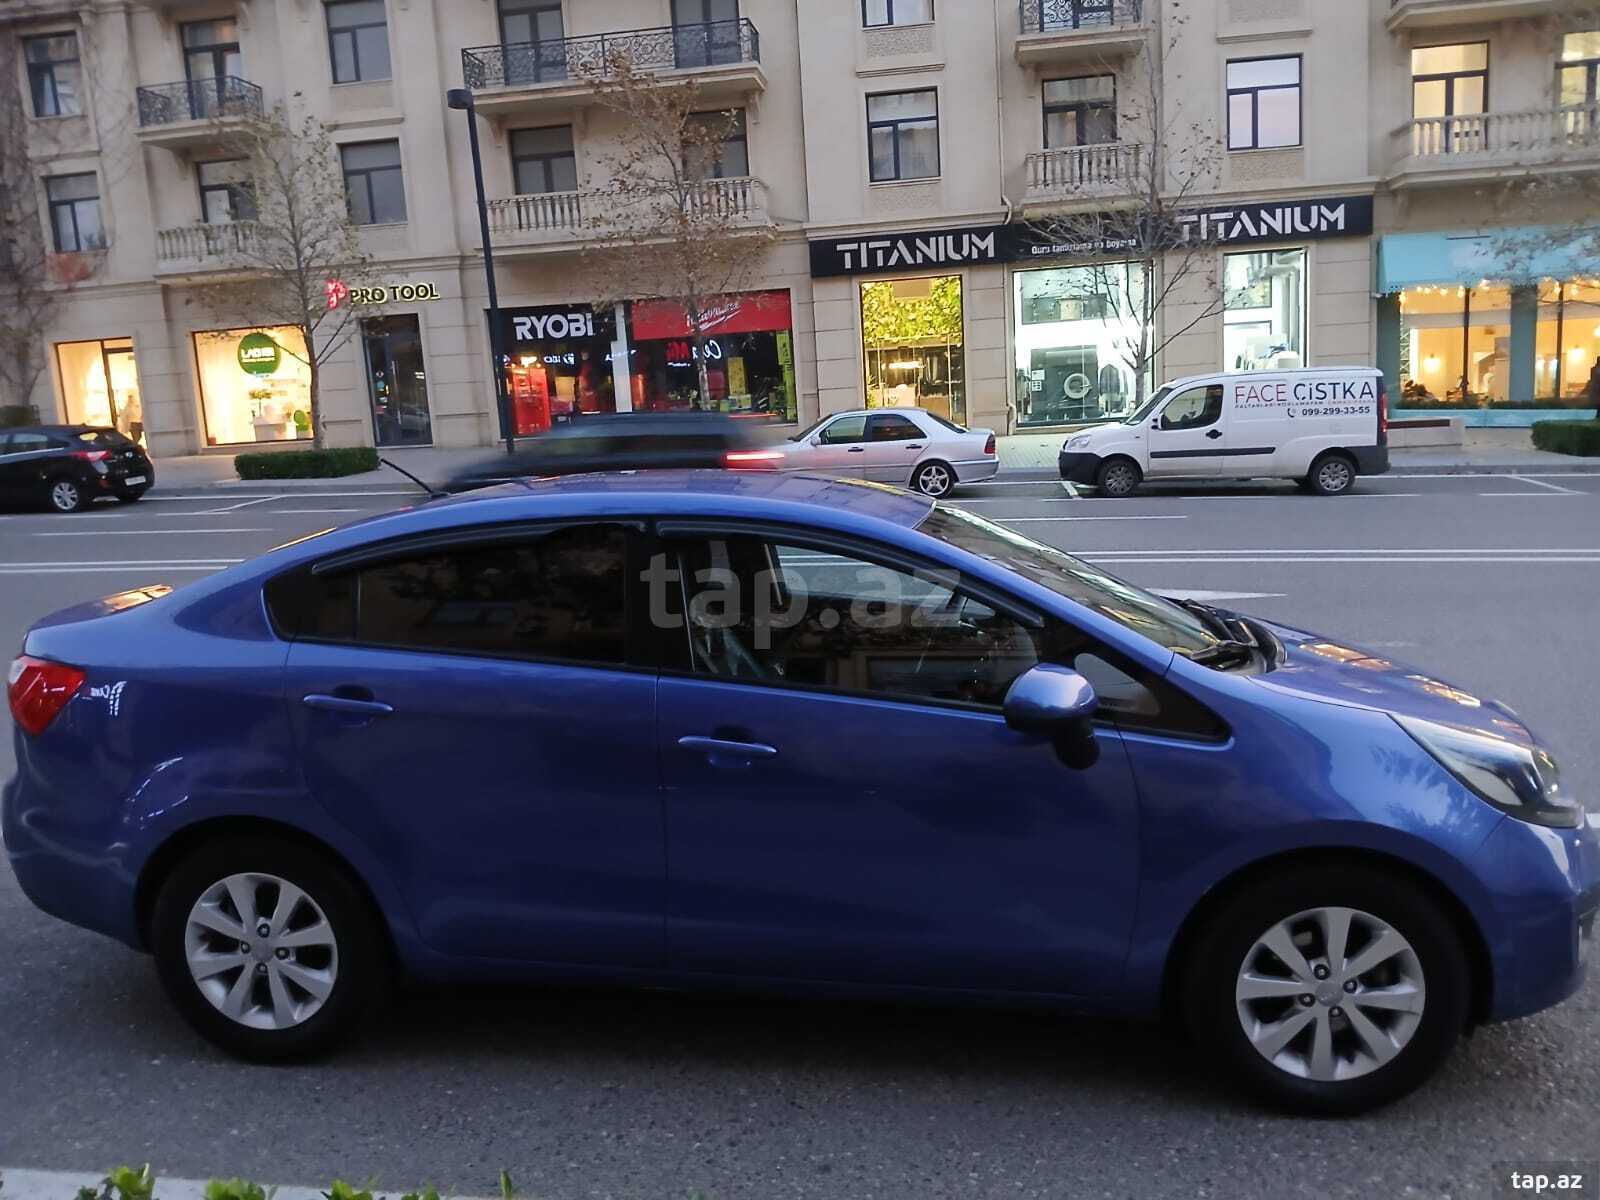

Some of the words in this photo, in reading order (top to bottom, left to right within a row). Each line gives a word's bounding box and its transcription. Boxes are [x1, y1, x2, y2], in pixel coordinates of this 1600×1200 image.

[1174, 203, 1345, 242] TITANIUM
[836, 231, 995, 269] TITANIUM
[349, 287, 387, 304] PRO
[390, 282, 440, 301] TOOL
[513, 312, 594, 341] RYOBI
[1234, 383, 1288, 404] FACE
[1301, 406, 1371, 416] 099-299-33-55
